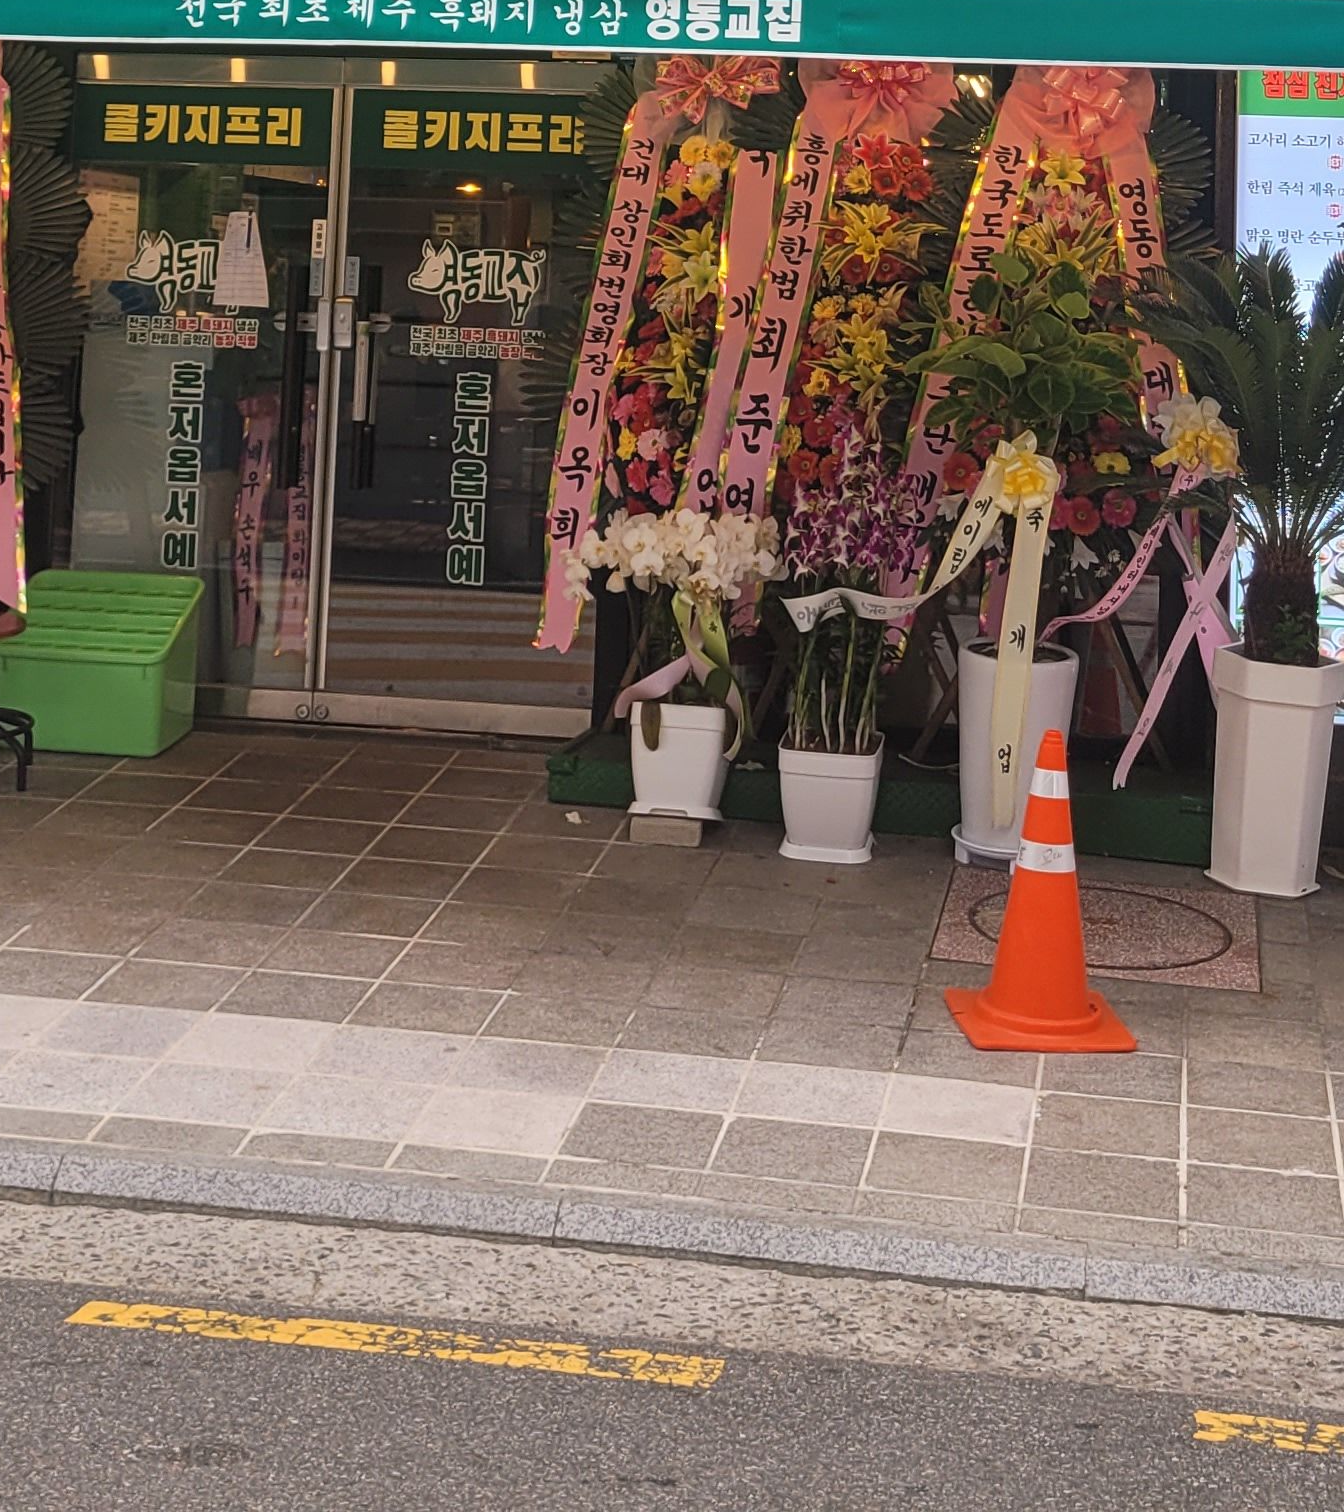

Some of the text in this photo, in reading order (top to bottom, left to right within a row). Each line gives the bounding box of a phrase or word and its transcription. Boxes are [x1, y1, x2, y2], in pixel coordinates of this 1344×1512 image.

[104, 104, 302, 147] 콜키지프리
[383, 110, 584, 154] 콜키지프리
[1247, 133, 1287, 148] 고사리
[1291, 134, 1332, 149] 소고기
[622, 138, 654, 186] 건대
[1247, 180, 1273, 195] 한림
[1278, 181, 1304, 195] 즉석
[1308, 182, 1336, 197] 제육
[1246, 228, 1273, 243] 맑은
[1277, 229, 1304, 244] 명란
[127, 316, 150, 330] 전국
[411, 325, 433, 340] 전국
[436, 326, 459, 341] 최초
[460, 327, 483, 342] 제주
[410, 343, 433, 356] 제주
[161, 360, 205, 569] 혼저옵서예
[446, 371, 492, 586] 혼저옵서예
[550, 388, 601, 550] 이옥희
